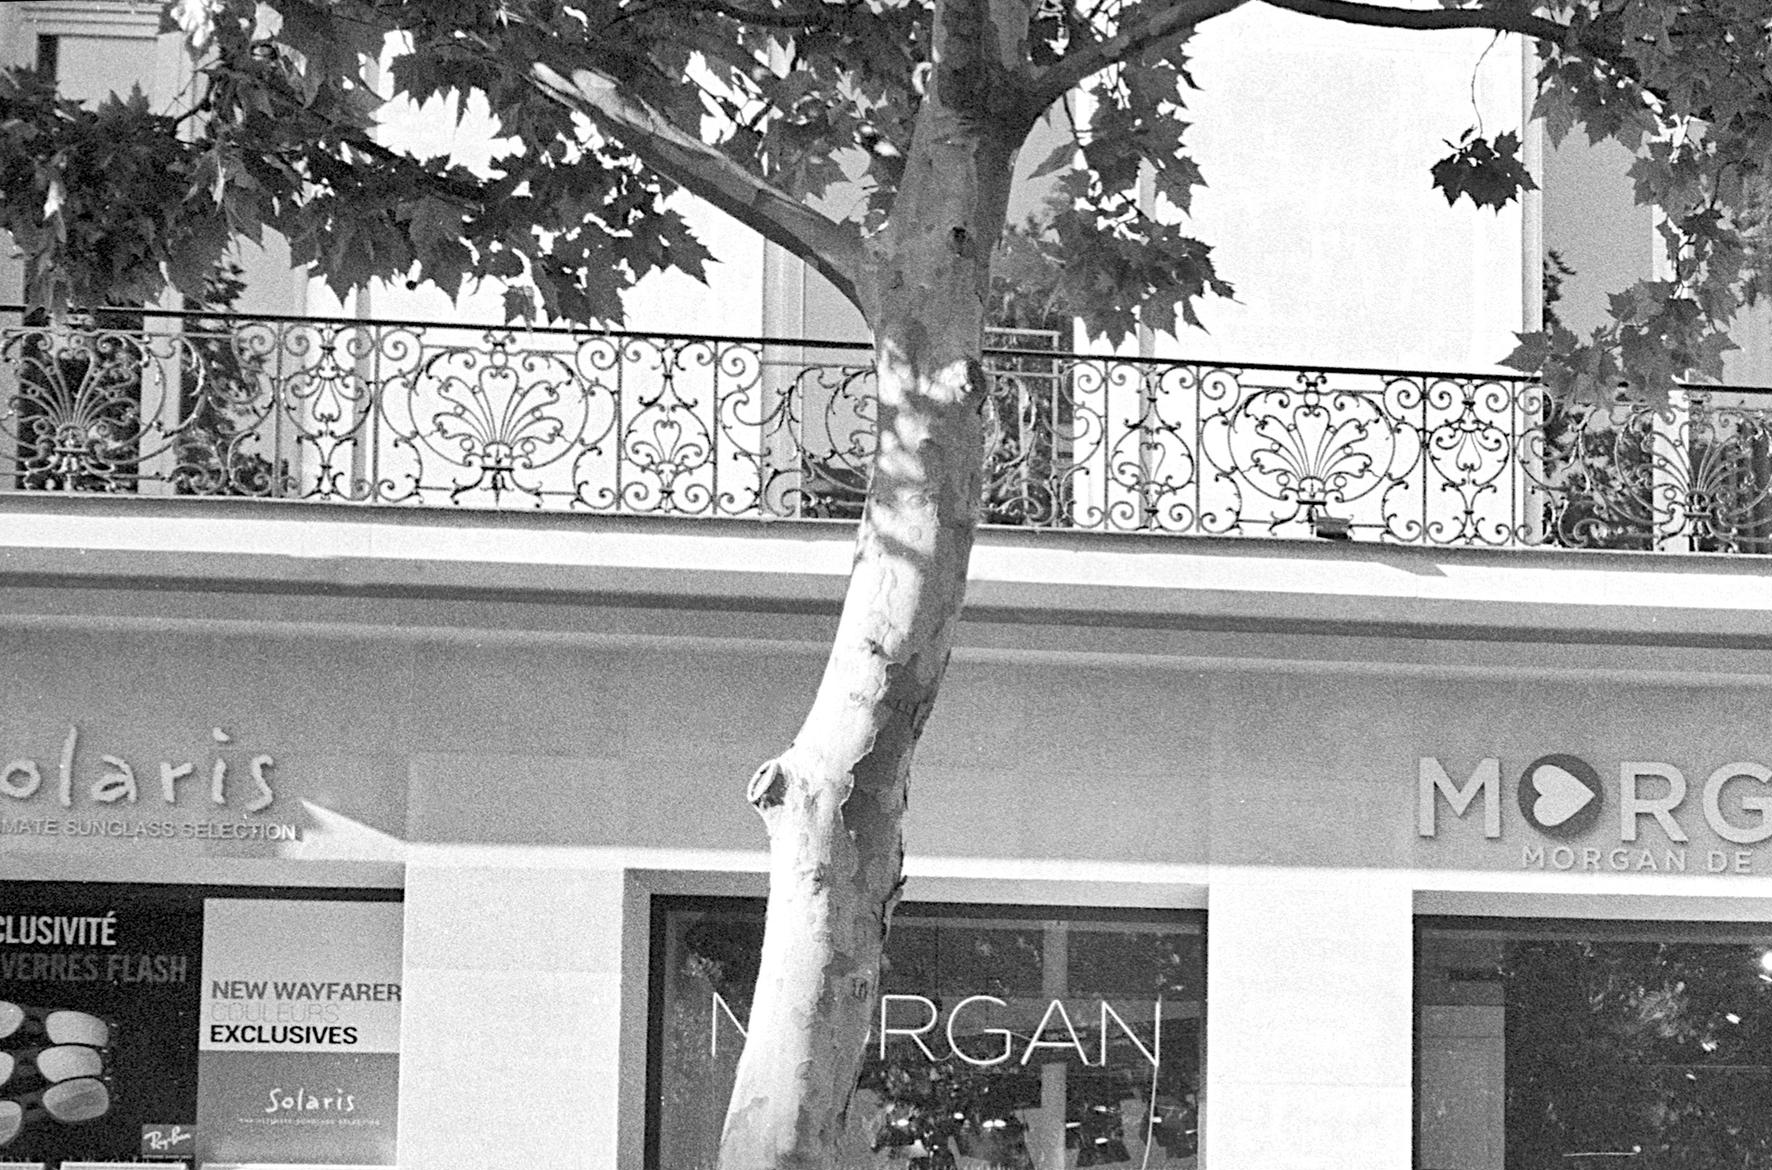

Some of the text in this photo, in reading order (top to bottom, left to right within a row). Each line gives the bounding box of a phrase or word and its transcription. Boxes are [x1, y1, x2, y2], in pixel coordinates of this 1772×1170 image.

[0, 725, 274, 812] olaris
[64, 820, 175, 837] SUNGLASS
[182, 823, 296, 841] SELECTION
[1522, 845, 1687, 872] MORGAN
[1707, 851, 1752, 874] DE
[106, 953, 187, 984] FLASH
[212, 980, 401, 1002] NEW WAYFARER
[210, 1002, 340, 1024] COULEURS
[210, 1024, 359, 1045] EXCLUSIVES
[711, 990, 1161, 1067] MRGAN
[265, 1087, 355, 1114] Solaris
